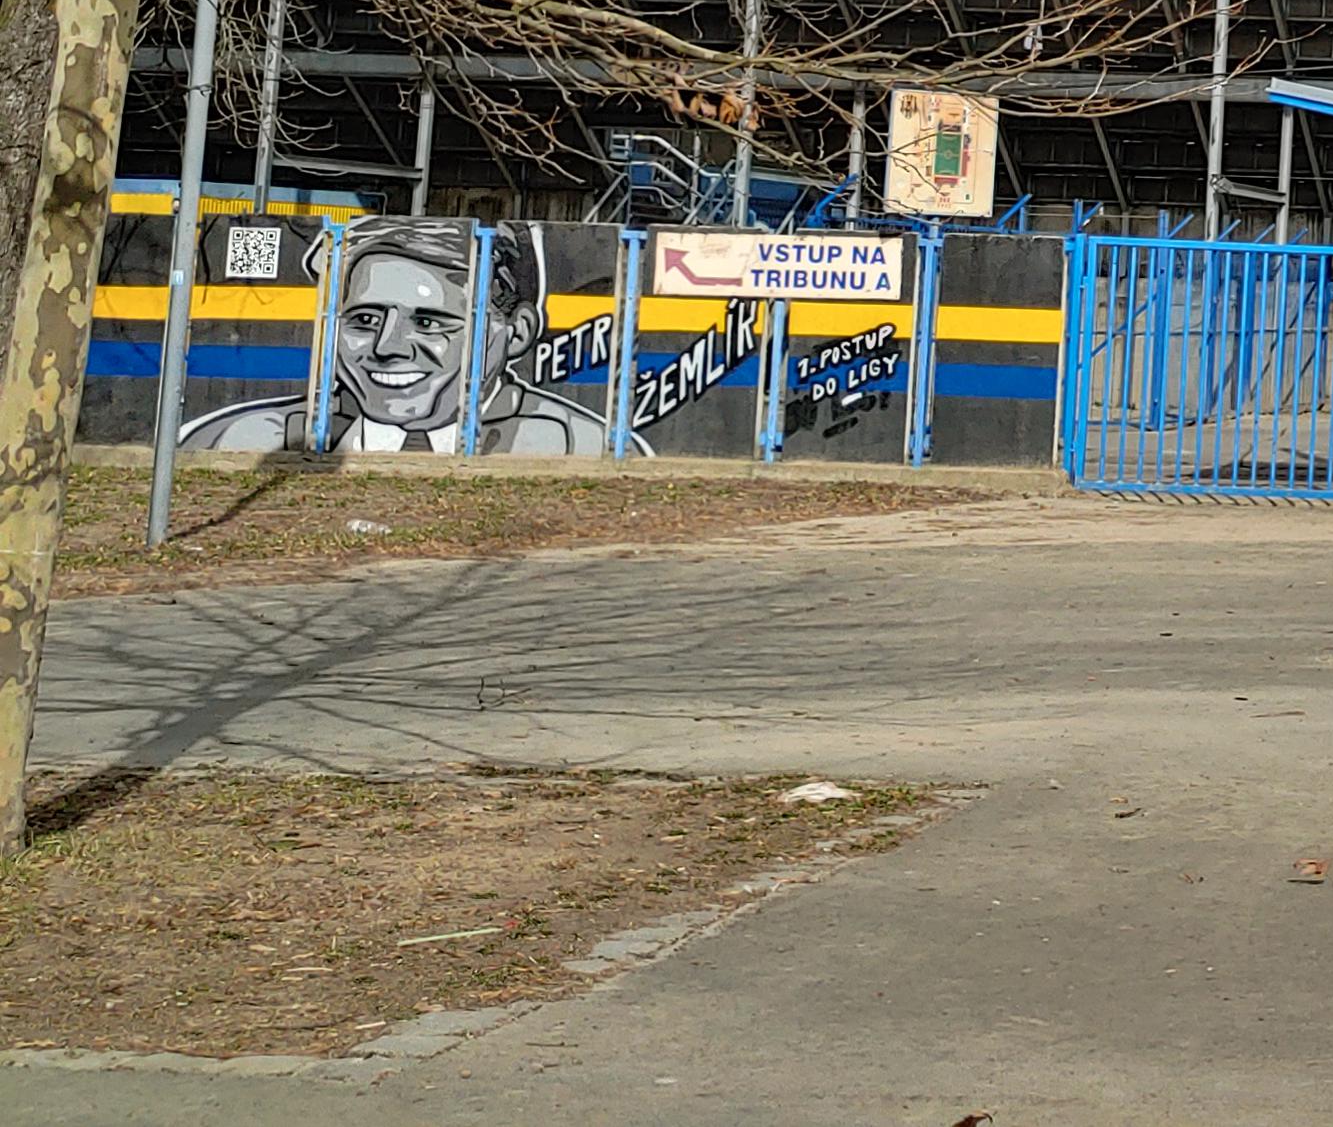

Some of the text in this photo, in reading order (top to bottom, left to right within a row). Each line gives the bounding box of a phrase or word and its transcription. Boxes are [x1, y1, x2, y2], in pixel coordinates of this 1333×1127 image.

[758, 243, 886, 265] VSTUP NA
[751, 268, 891, 291] TRIBUNU A
[535, 297, 758, 429] PETR ŽEMLÍK
[819, 324, 894, 369] POSTUP
[812, 353, 899, 402] DO LIGY
